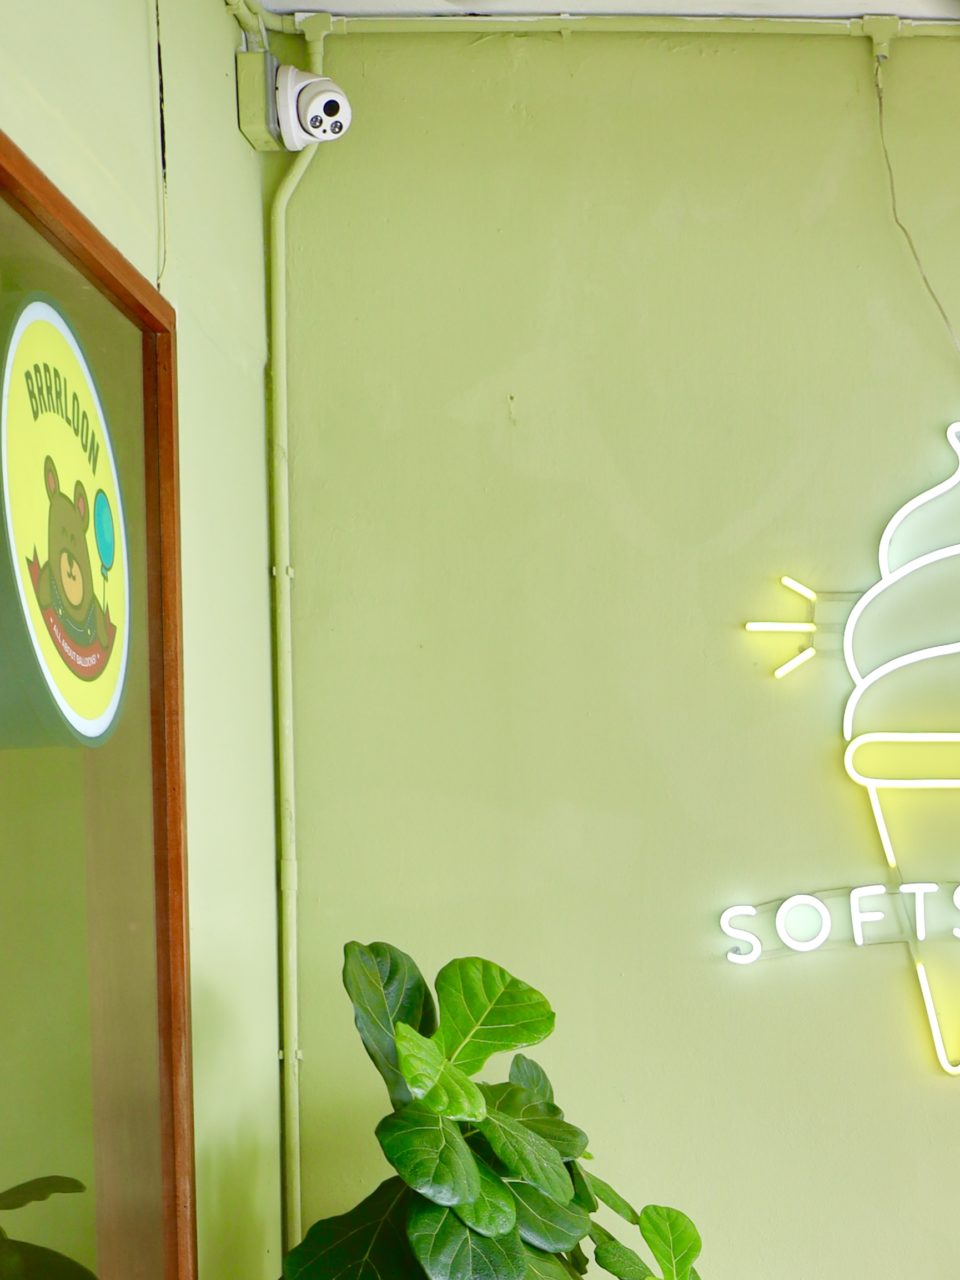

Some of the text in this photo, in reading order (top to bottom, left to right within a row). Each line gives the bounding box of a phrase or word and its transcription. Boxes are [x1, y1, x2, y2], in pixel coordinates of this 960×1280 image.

[24, 363, 100, 477] BRRRLOON
[53, 624, 62, 644] ALL
[61, 639, 77, 661] ABOUT
